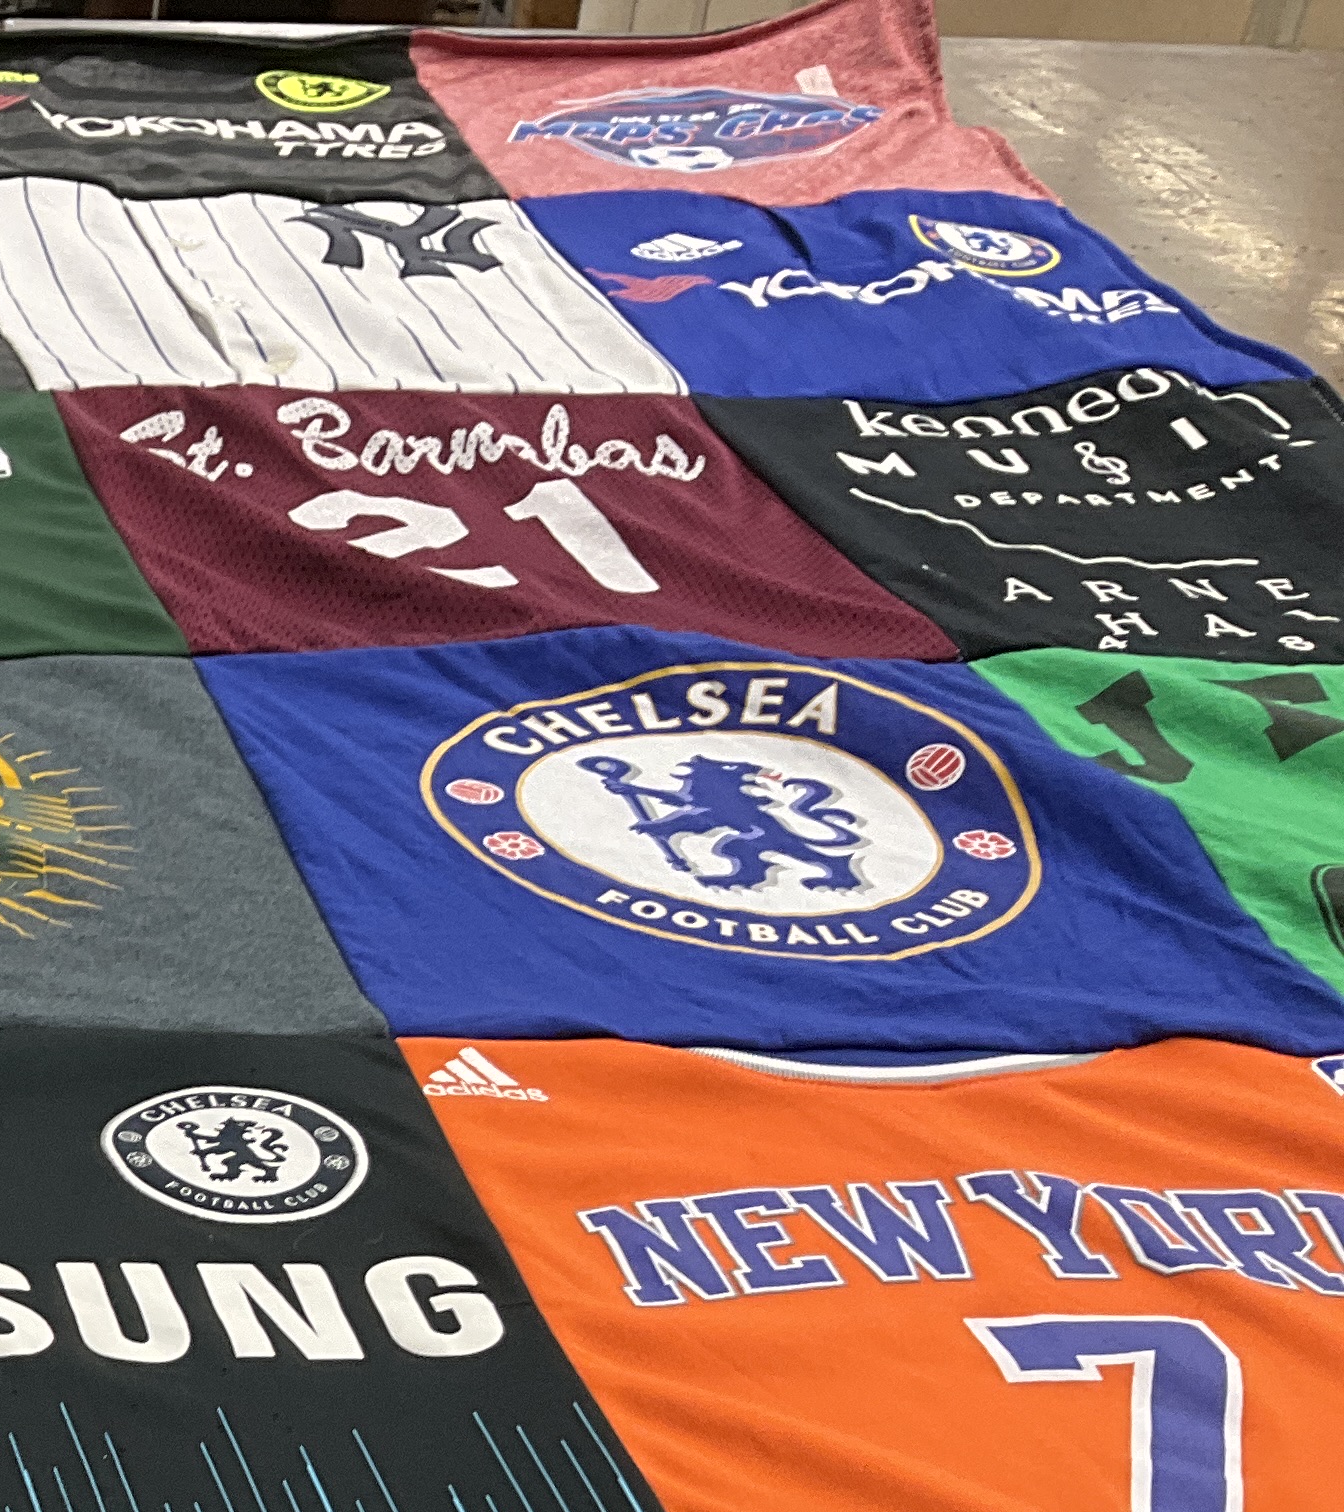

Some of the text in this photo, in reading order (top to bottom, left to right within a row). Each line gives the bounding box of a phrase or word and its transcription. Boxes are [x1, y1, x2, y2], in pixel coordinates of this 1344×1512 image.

[31, 100, 447, 144] YOKOHAMA
[954, 453, 1282, 507] DEPARTMENT
[287, 477, 661, 593] 21
[483, 677, 839, 756] CHELSEA
[595, 886, 991, 947] FOOTBALL CLUB
[139, 1094, 294, 1123] CHELSEA
[422, 1080, 550, 1103] adidas
[164, 1180, 330, 1211] FOOTBALL CLUB
[575, 1181, 973, 1308] NEW
